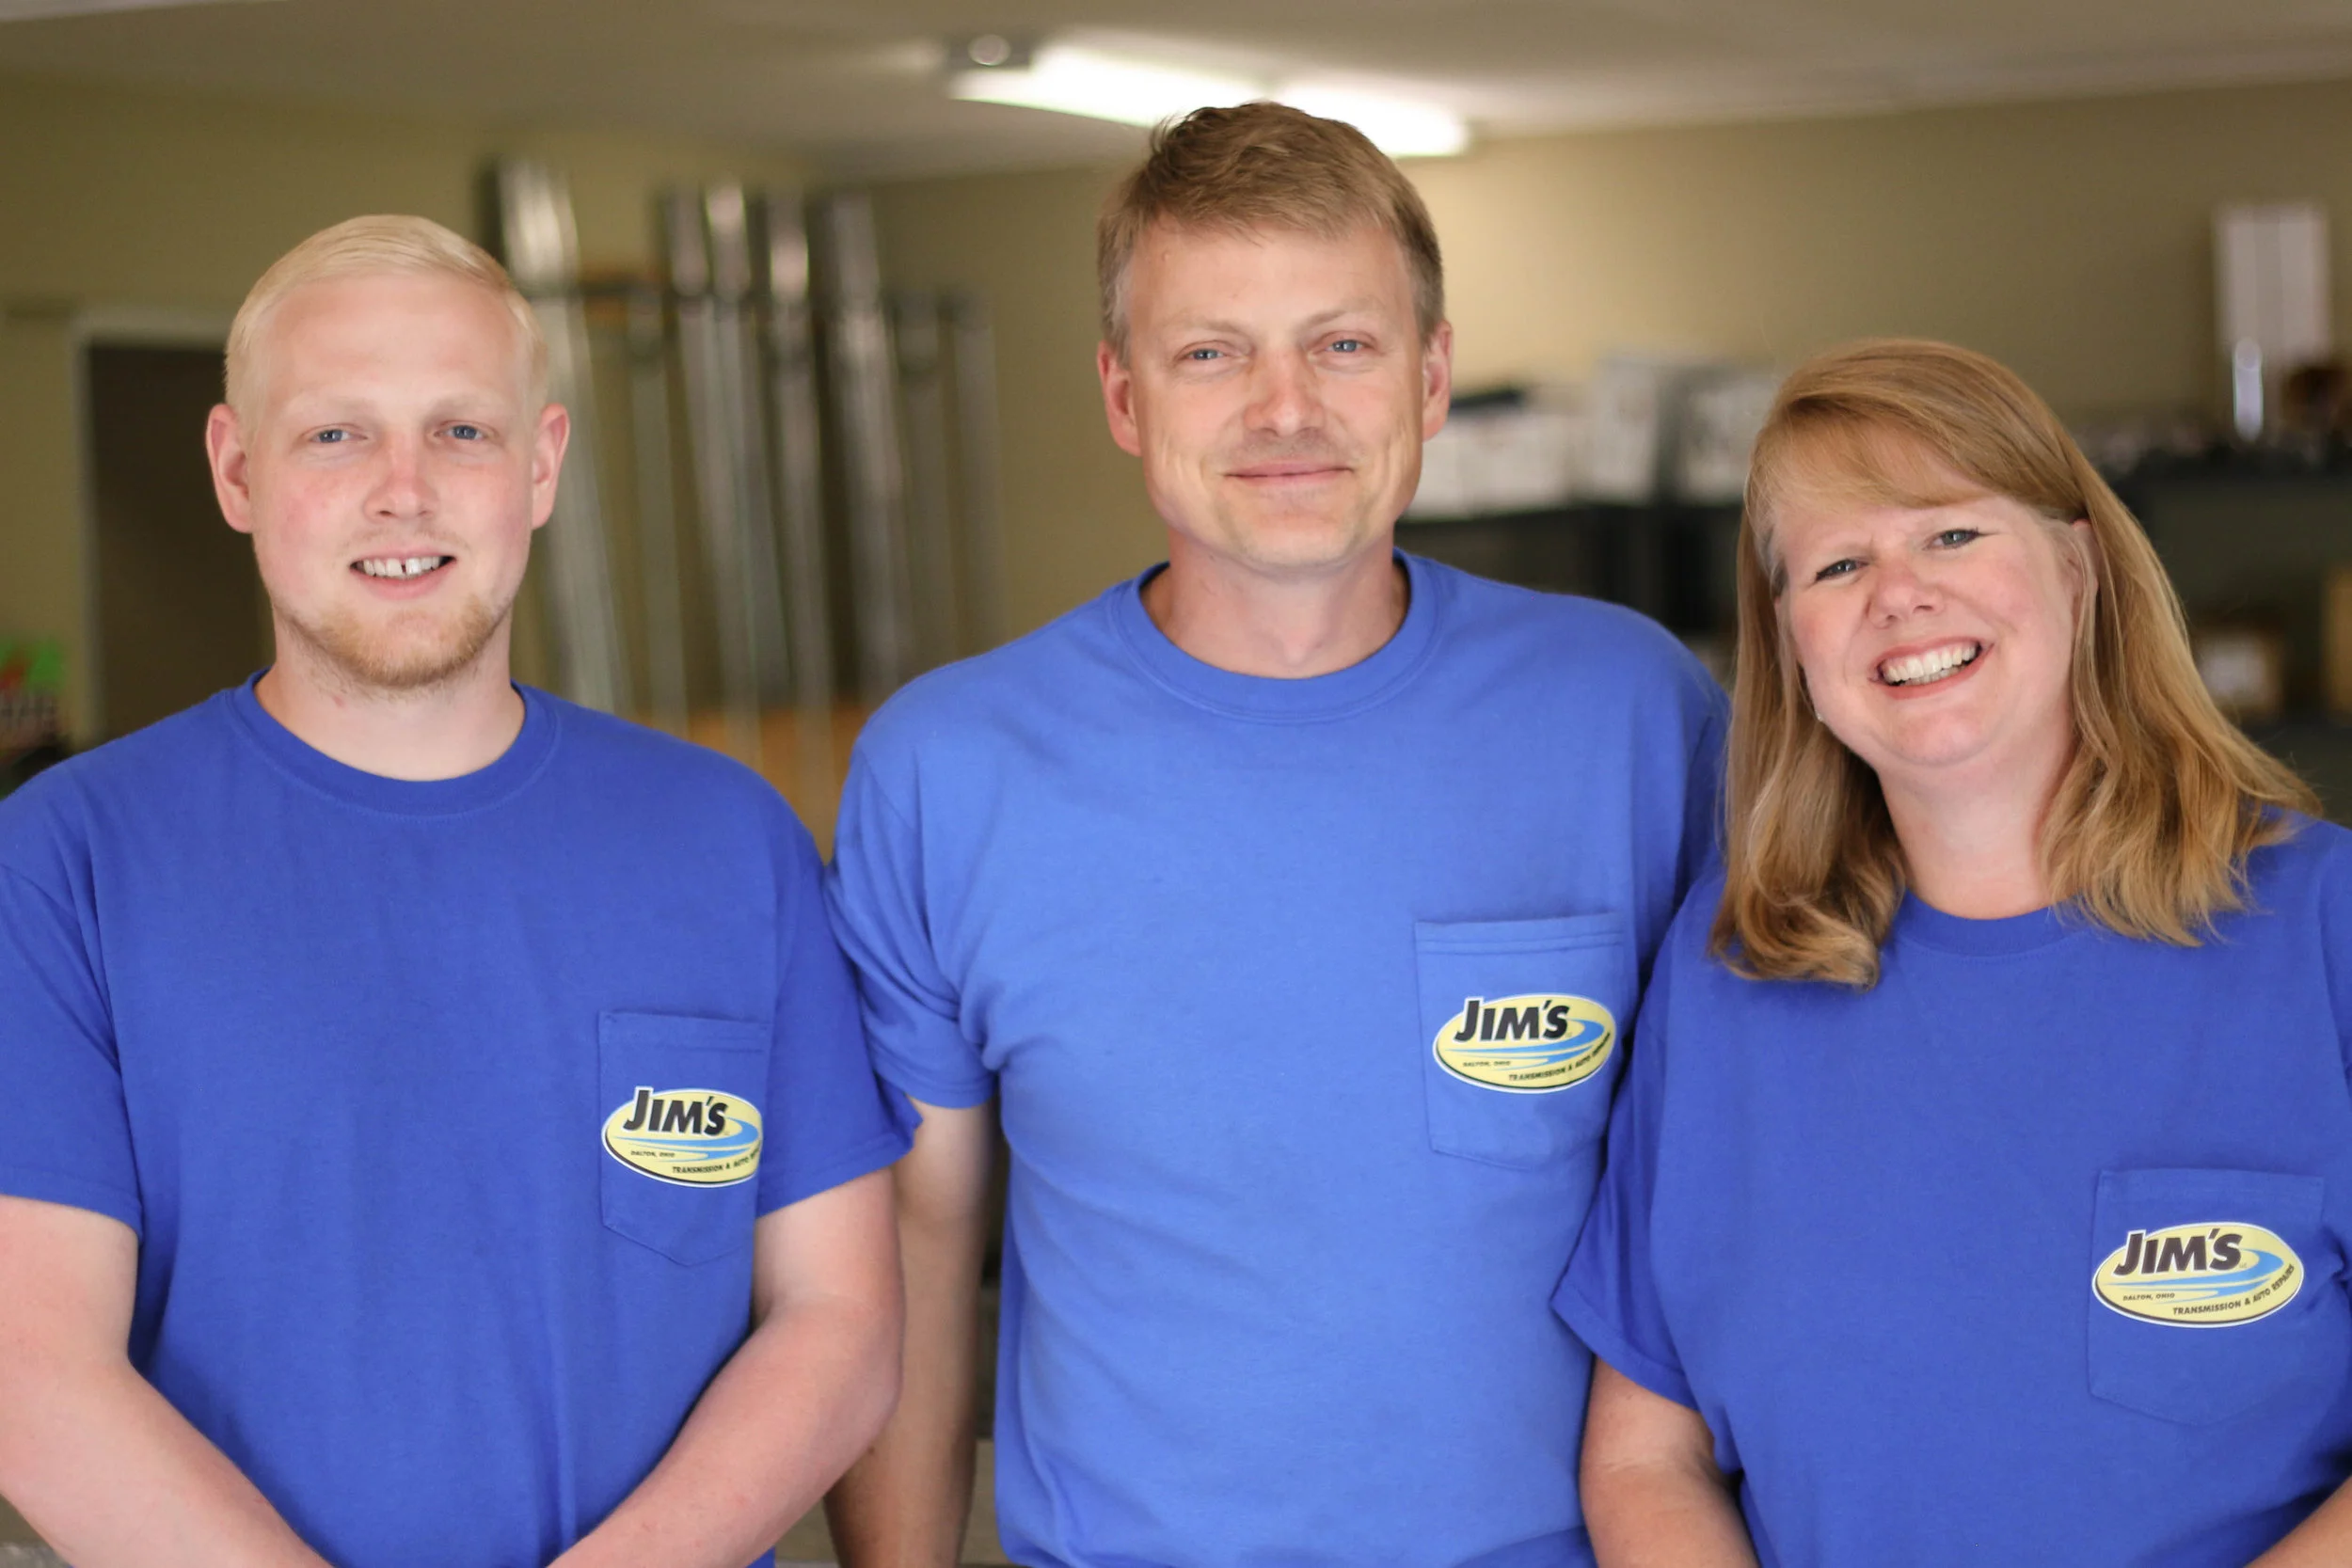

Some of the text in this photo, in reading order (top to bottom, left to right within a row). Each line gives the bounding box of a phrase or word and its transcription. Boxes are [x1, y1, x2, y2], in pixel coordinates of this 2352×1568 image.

[1454, 1000, 1570, 1041] JIM'S
[623, 1089, 729, 1136] JIM'S
[672, 1165, 723, 1174] TRANSMISSION
[2113, 1227, 2243, 1275] JIM'S
[2172, 1301, 2241, 1316] TRANSMISSION
[2252, 1288, 2271, 1303] AUTO
[2271, 1263, 2295, 1291] REPAIRS
